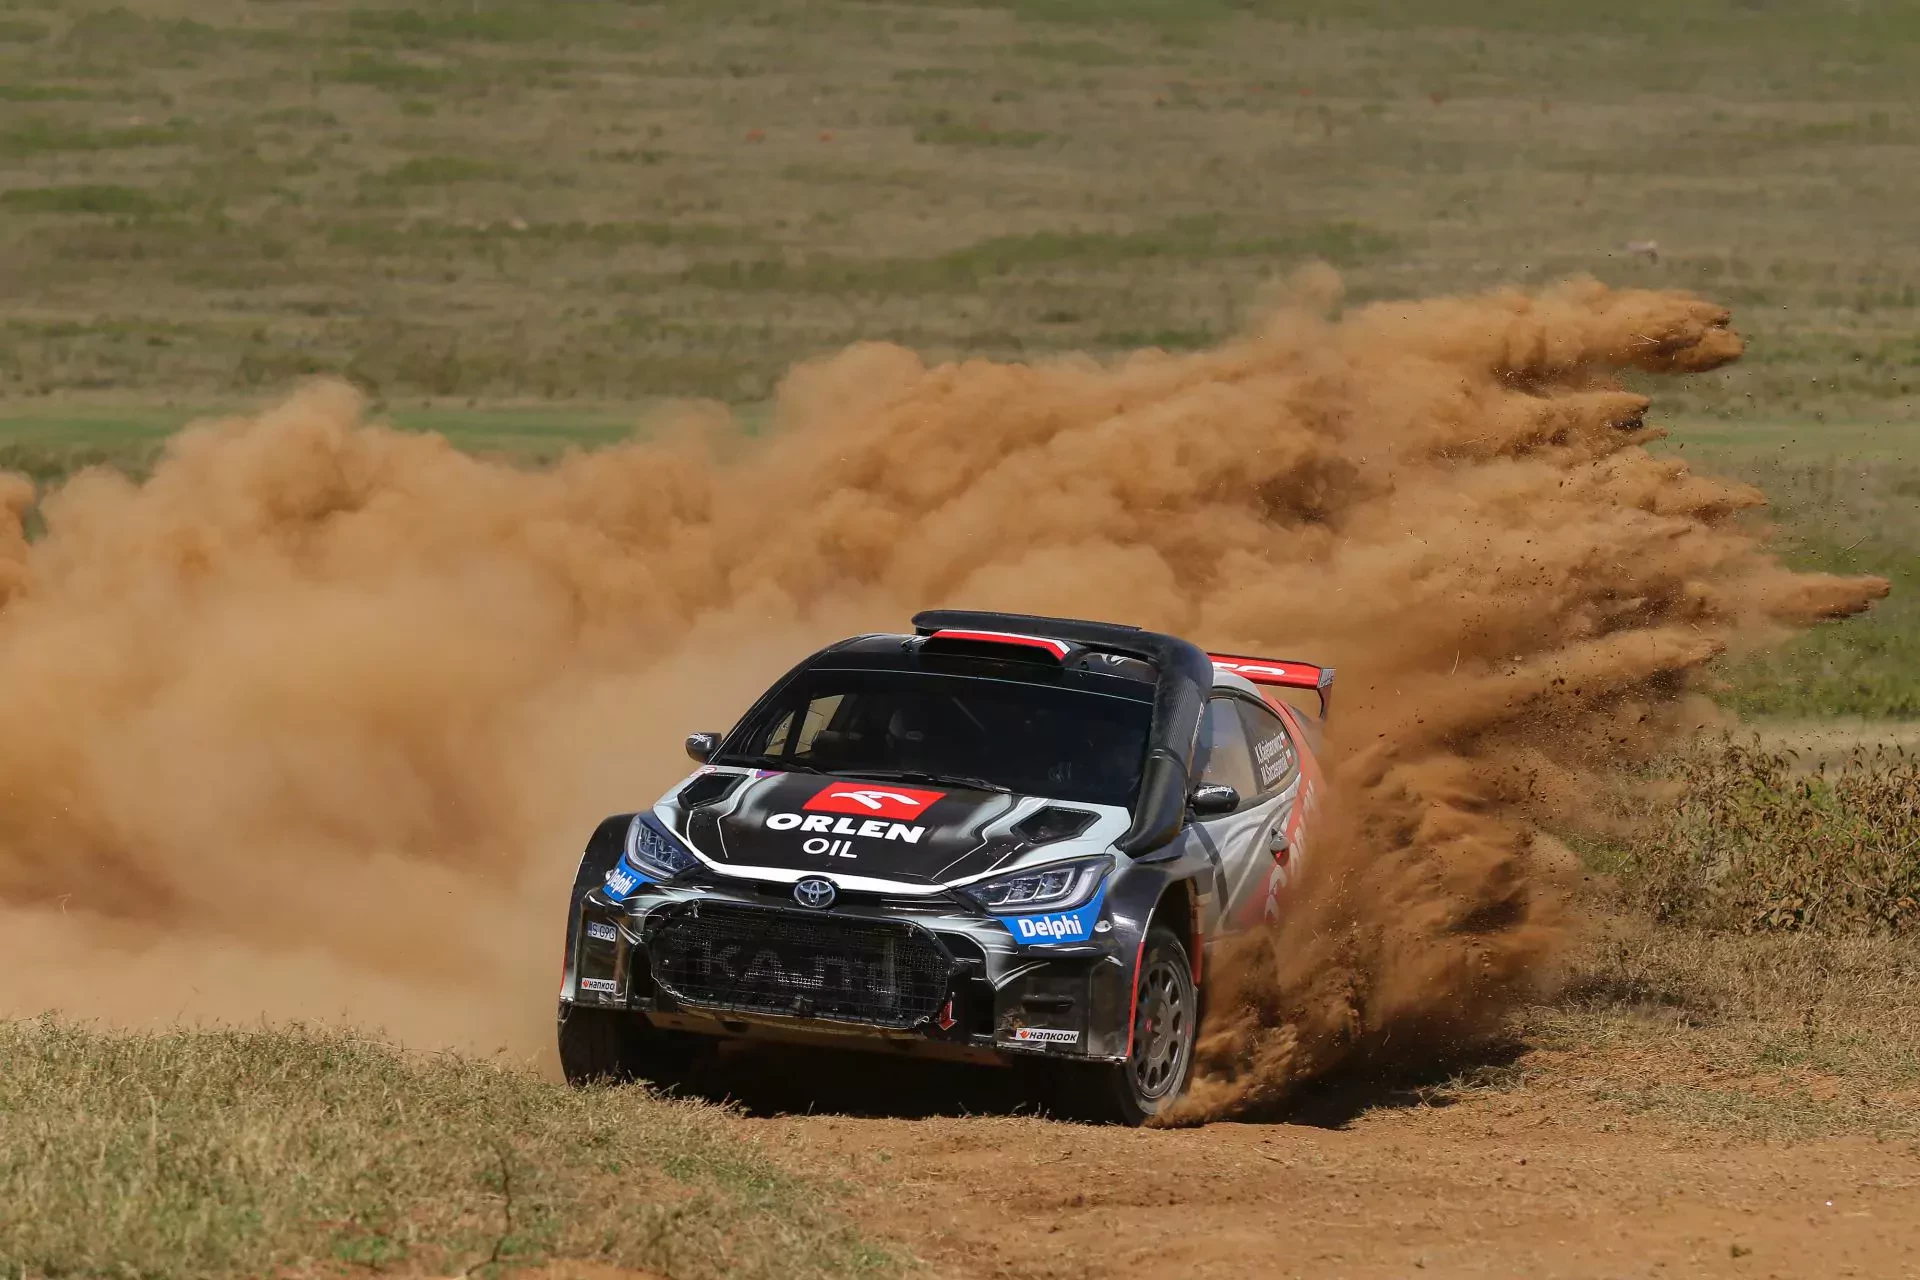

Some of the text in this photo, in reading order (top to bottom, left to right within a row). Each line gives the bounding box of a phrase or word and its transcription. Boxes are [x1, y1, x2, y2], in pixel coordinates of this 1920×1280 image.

[766, 813, 926, 844] ORLEN
[802, 838, 858, 859] OIL
[607, 868, 637, 895] Delphi
[1017, 915, 1084, 940] Delphi
